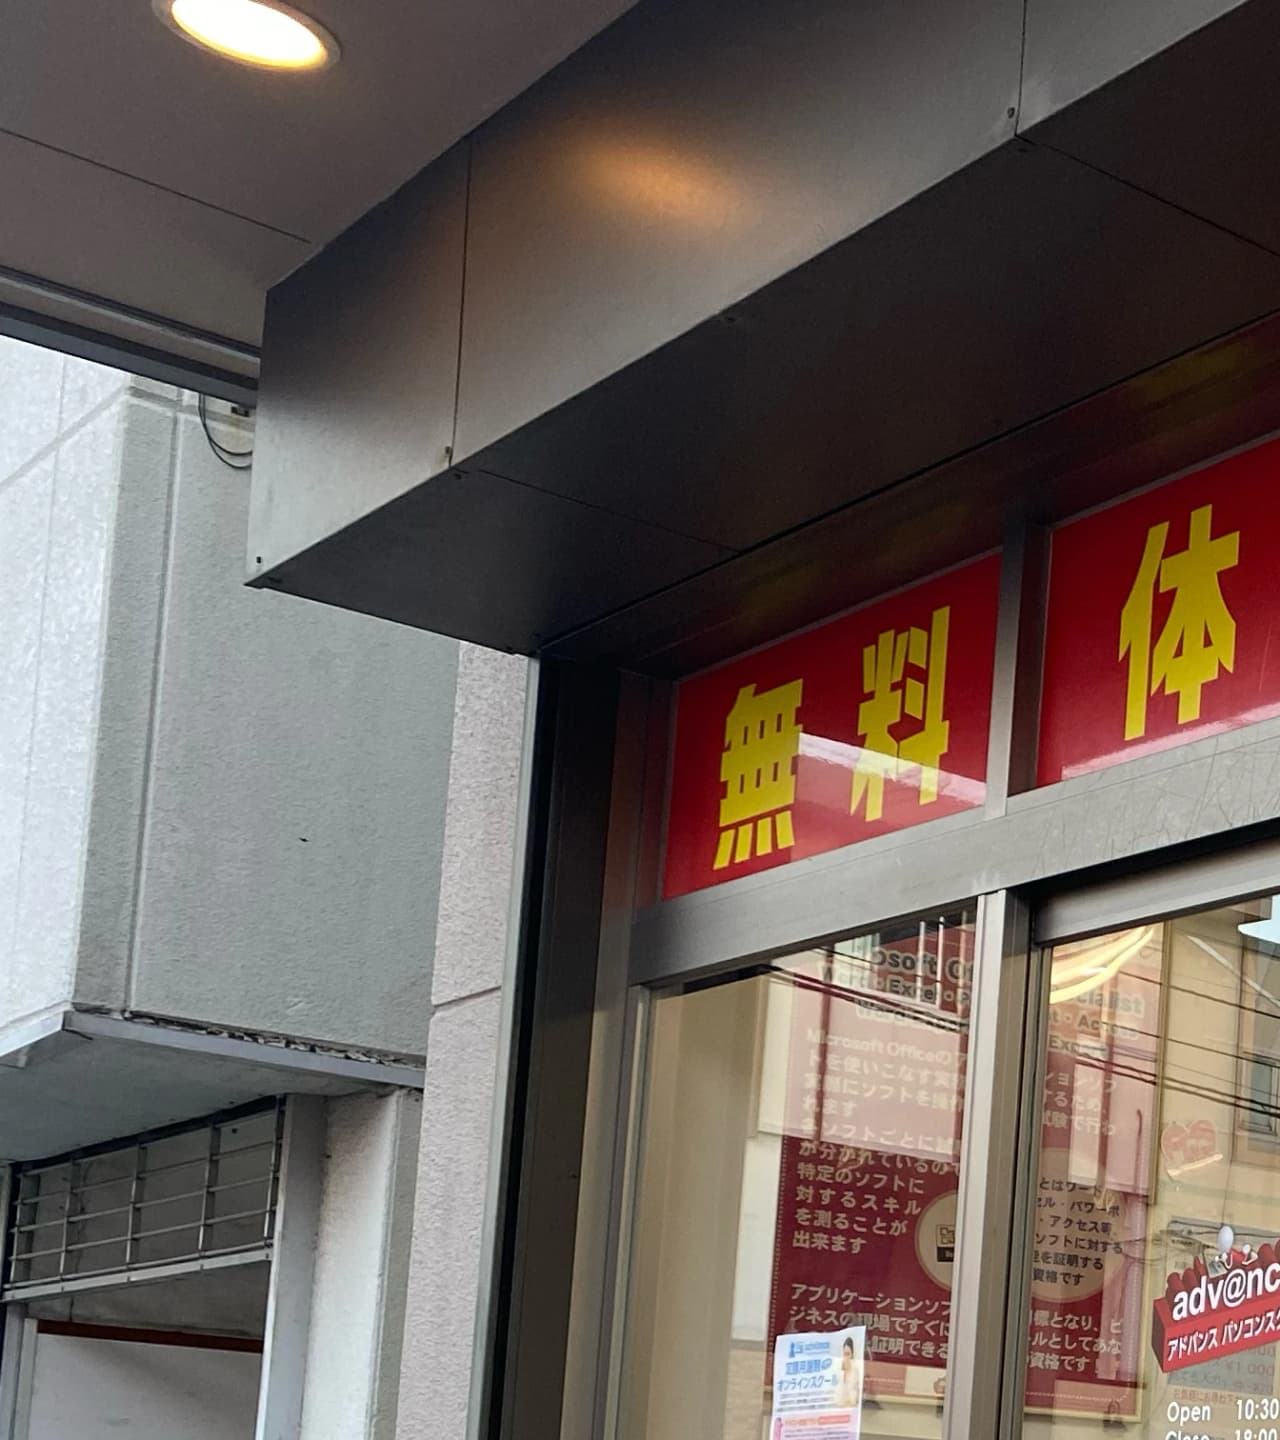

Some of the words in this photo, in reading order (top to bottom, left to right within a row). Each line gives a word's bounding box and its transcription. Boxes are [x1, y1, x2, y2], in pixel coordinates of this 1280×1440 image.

[713, 605, 951, 870] 無料
[797, 1161, 925, 1195] 特定のソフトに
[795, 1184, 922, 1216] 対するスキル
[794, 1207, 909, 1237] を測ることが
[792, 1230, 868, 1255] 出来ます
[1166, 1326, 1218, 1363] アドバンス
[1167, 1402, 1211, 1426] Open
